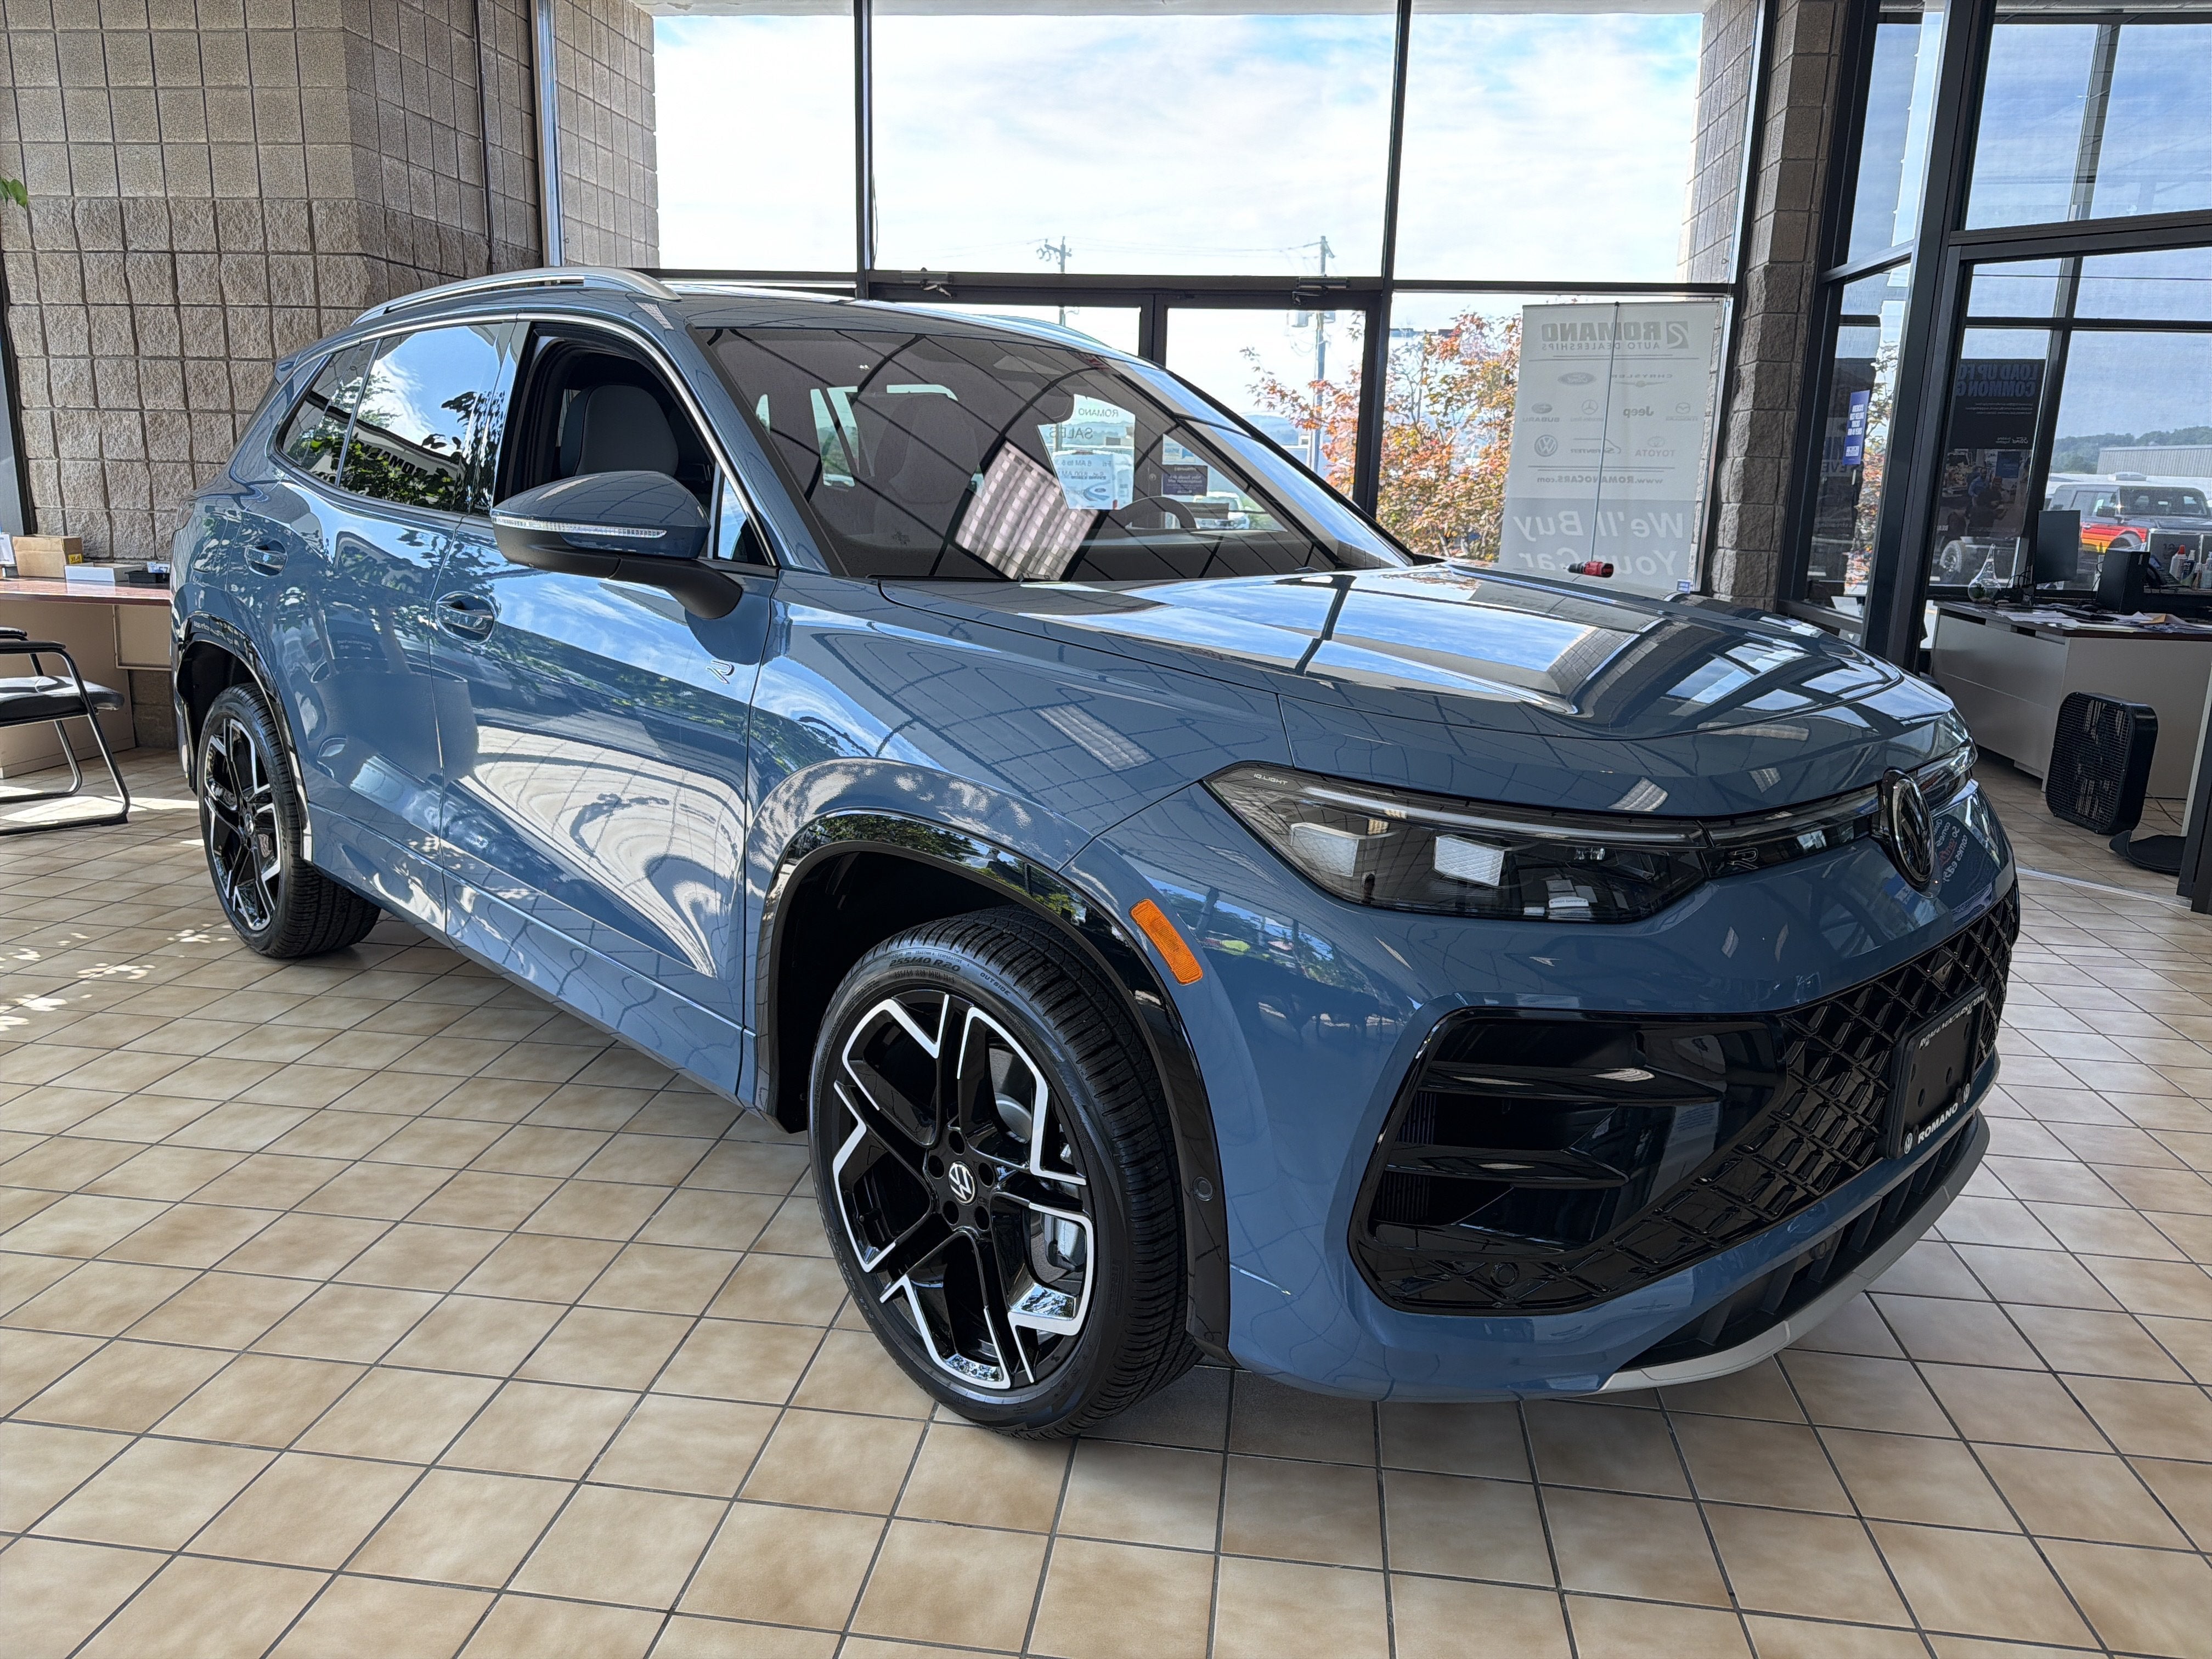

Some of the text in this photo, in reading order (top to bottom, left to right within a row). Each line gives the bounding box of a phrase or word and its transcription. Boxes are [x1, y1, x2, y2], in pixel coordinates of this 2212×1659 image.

[889, 957, 961, 972] 255/40 R20
[980, 972, 1012, 996] OUTSIDE
[1917, 1102, 1959, 1144] ROMANO
